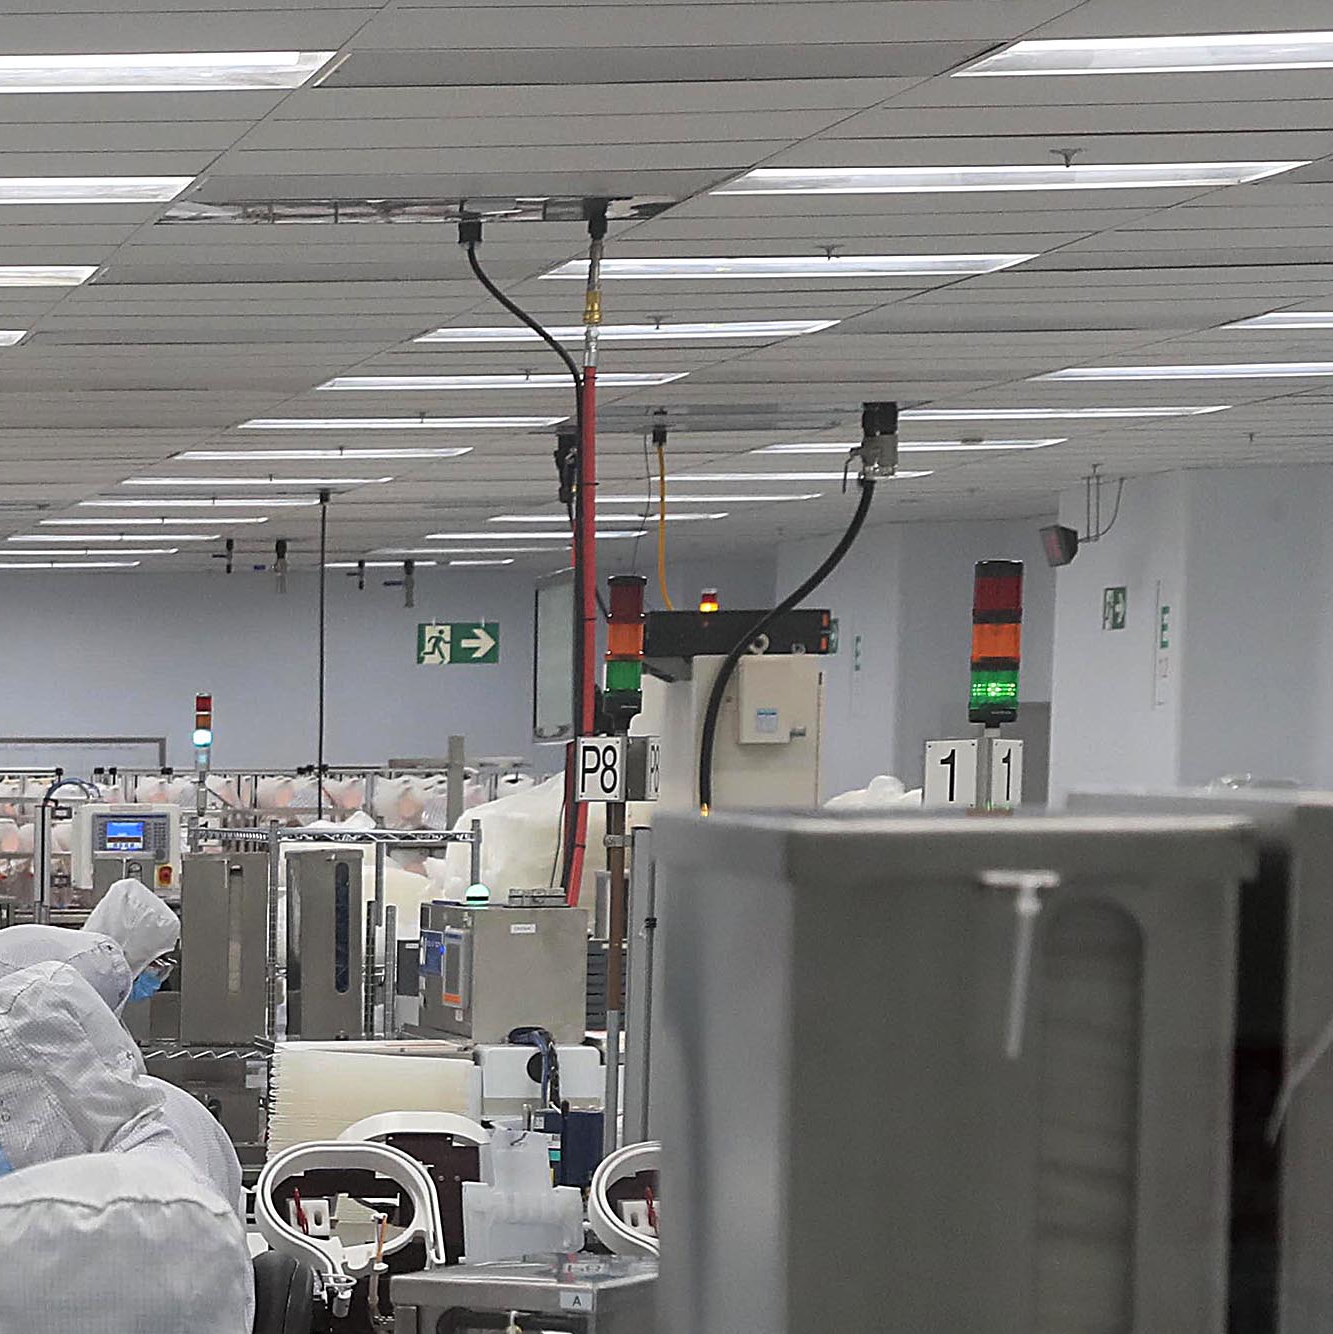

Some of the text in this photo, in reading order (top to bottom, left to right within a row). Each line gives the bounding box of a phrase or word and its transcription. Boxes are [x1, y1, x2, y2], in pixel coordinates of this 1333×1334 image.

[581, 745, 618, 794] P8
[940, 748, 955, 802] 1
[1002, 748, 1011, 802] 1
[572, 1295, 582, 1306] A
